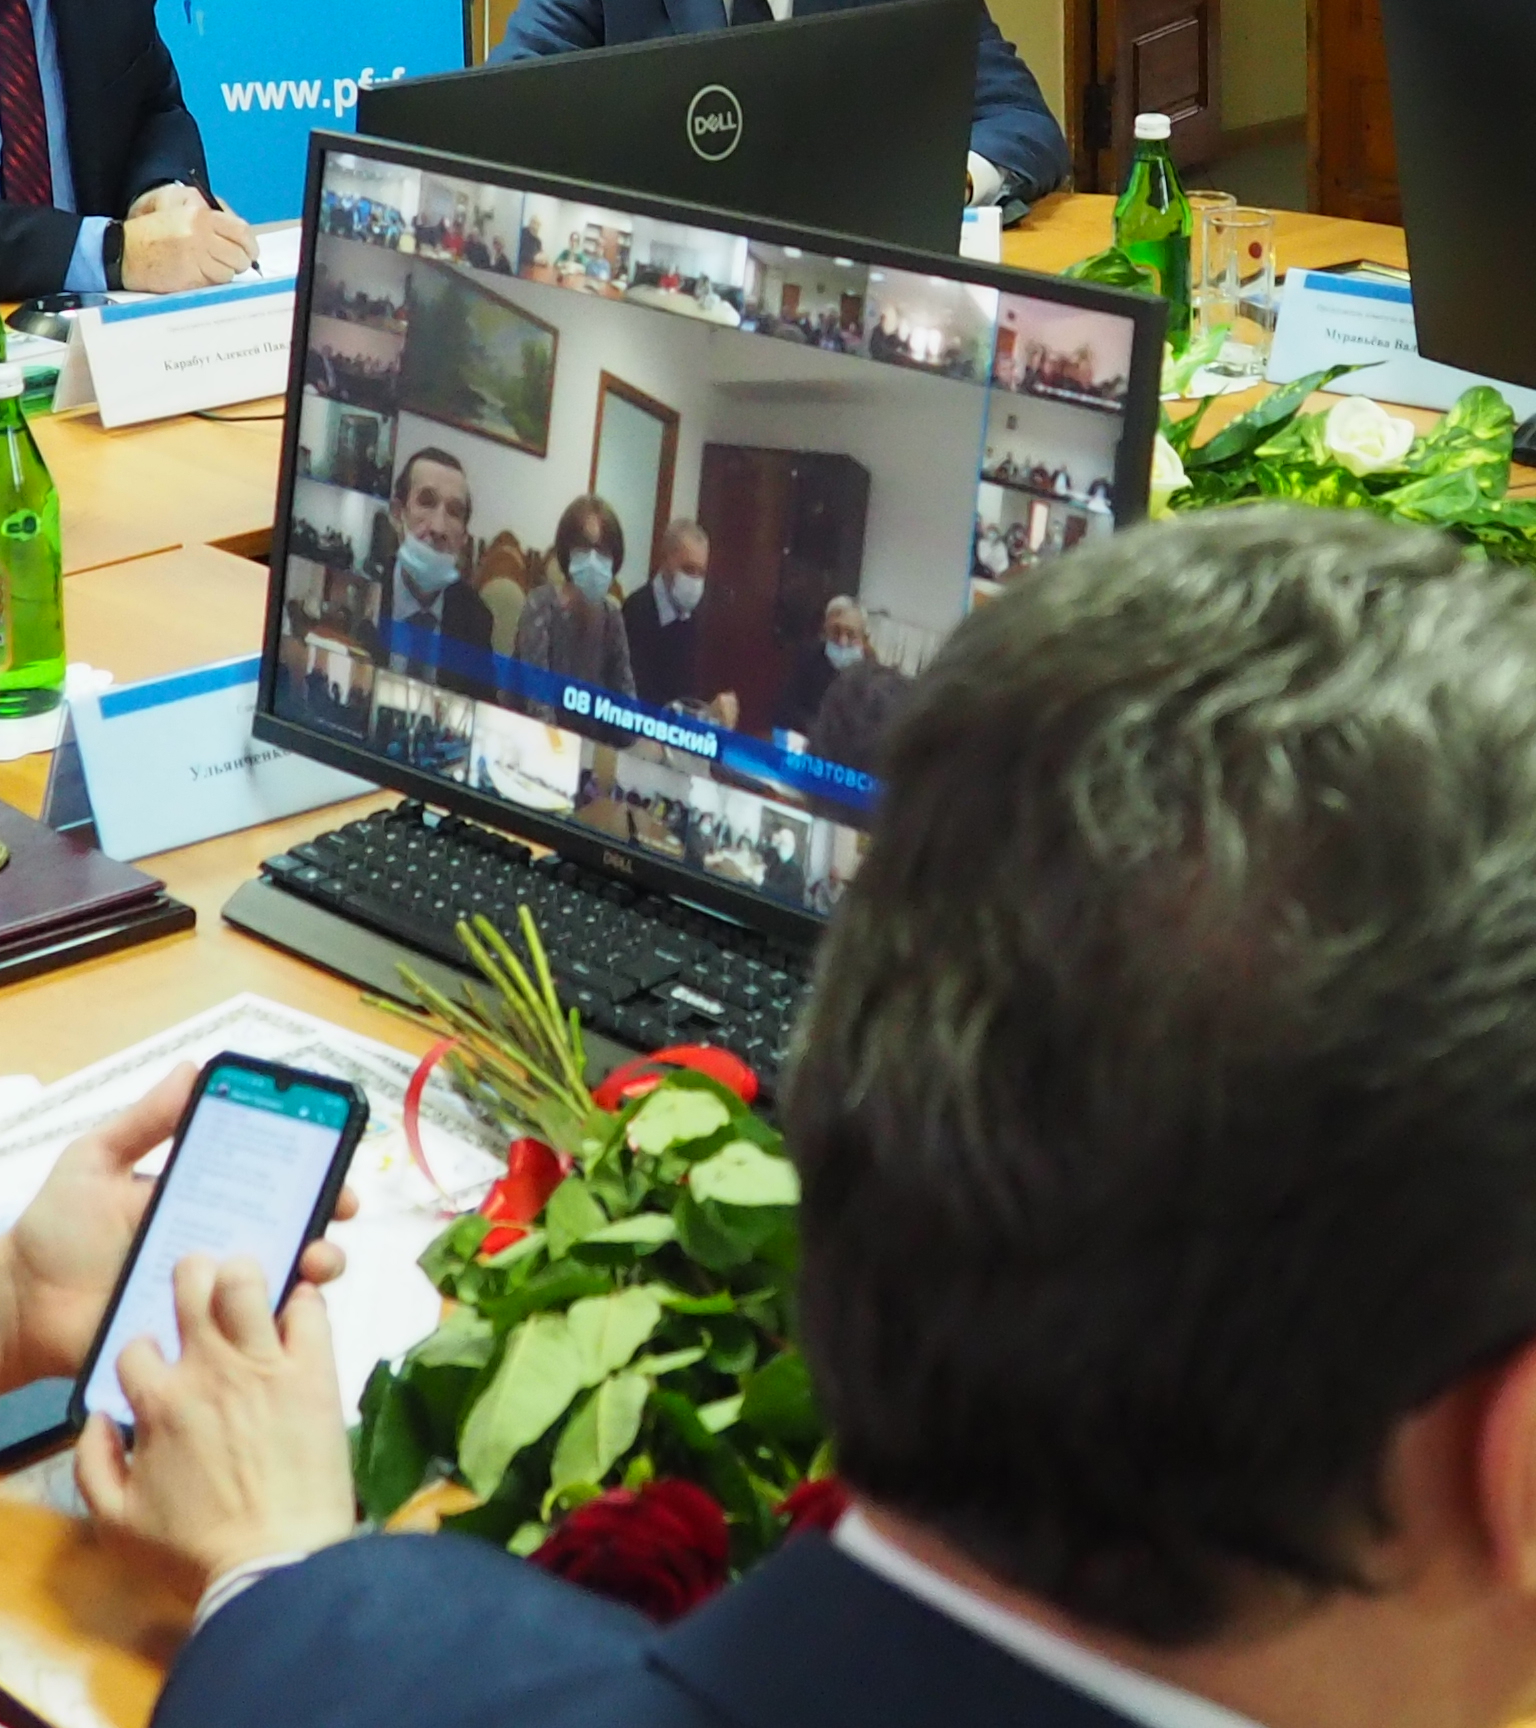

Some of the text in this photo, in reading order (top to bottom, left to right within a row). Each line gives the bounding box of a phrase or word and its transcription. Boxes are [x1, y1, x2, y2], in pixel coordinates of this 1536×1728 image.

[694, 110, 738, 136] DELL
[563, 685, 719, 758] 08 Ипатовский
